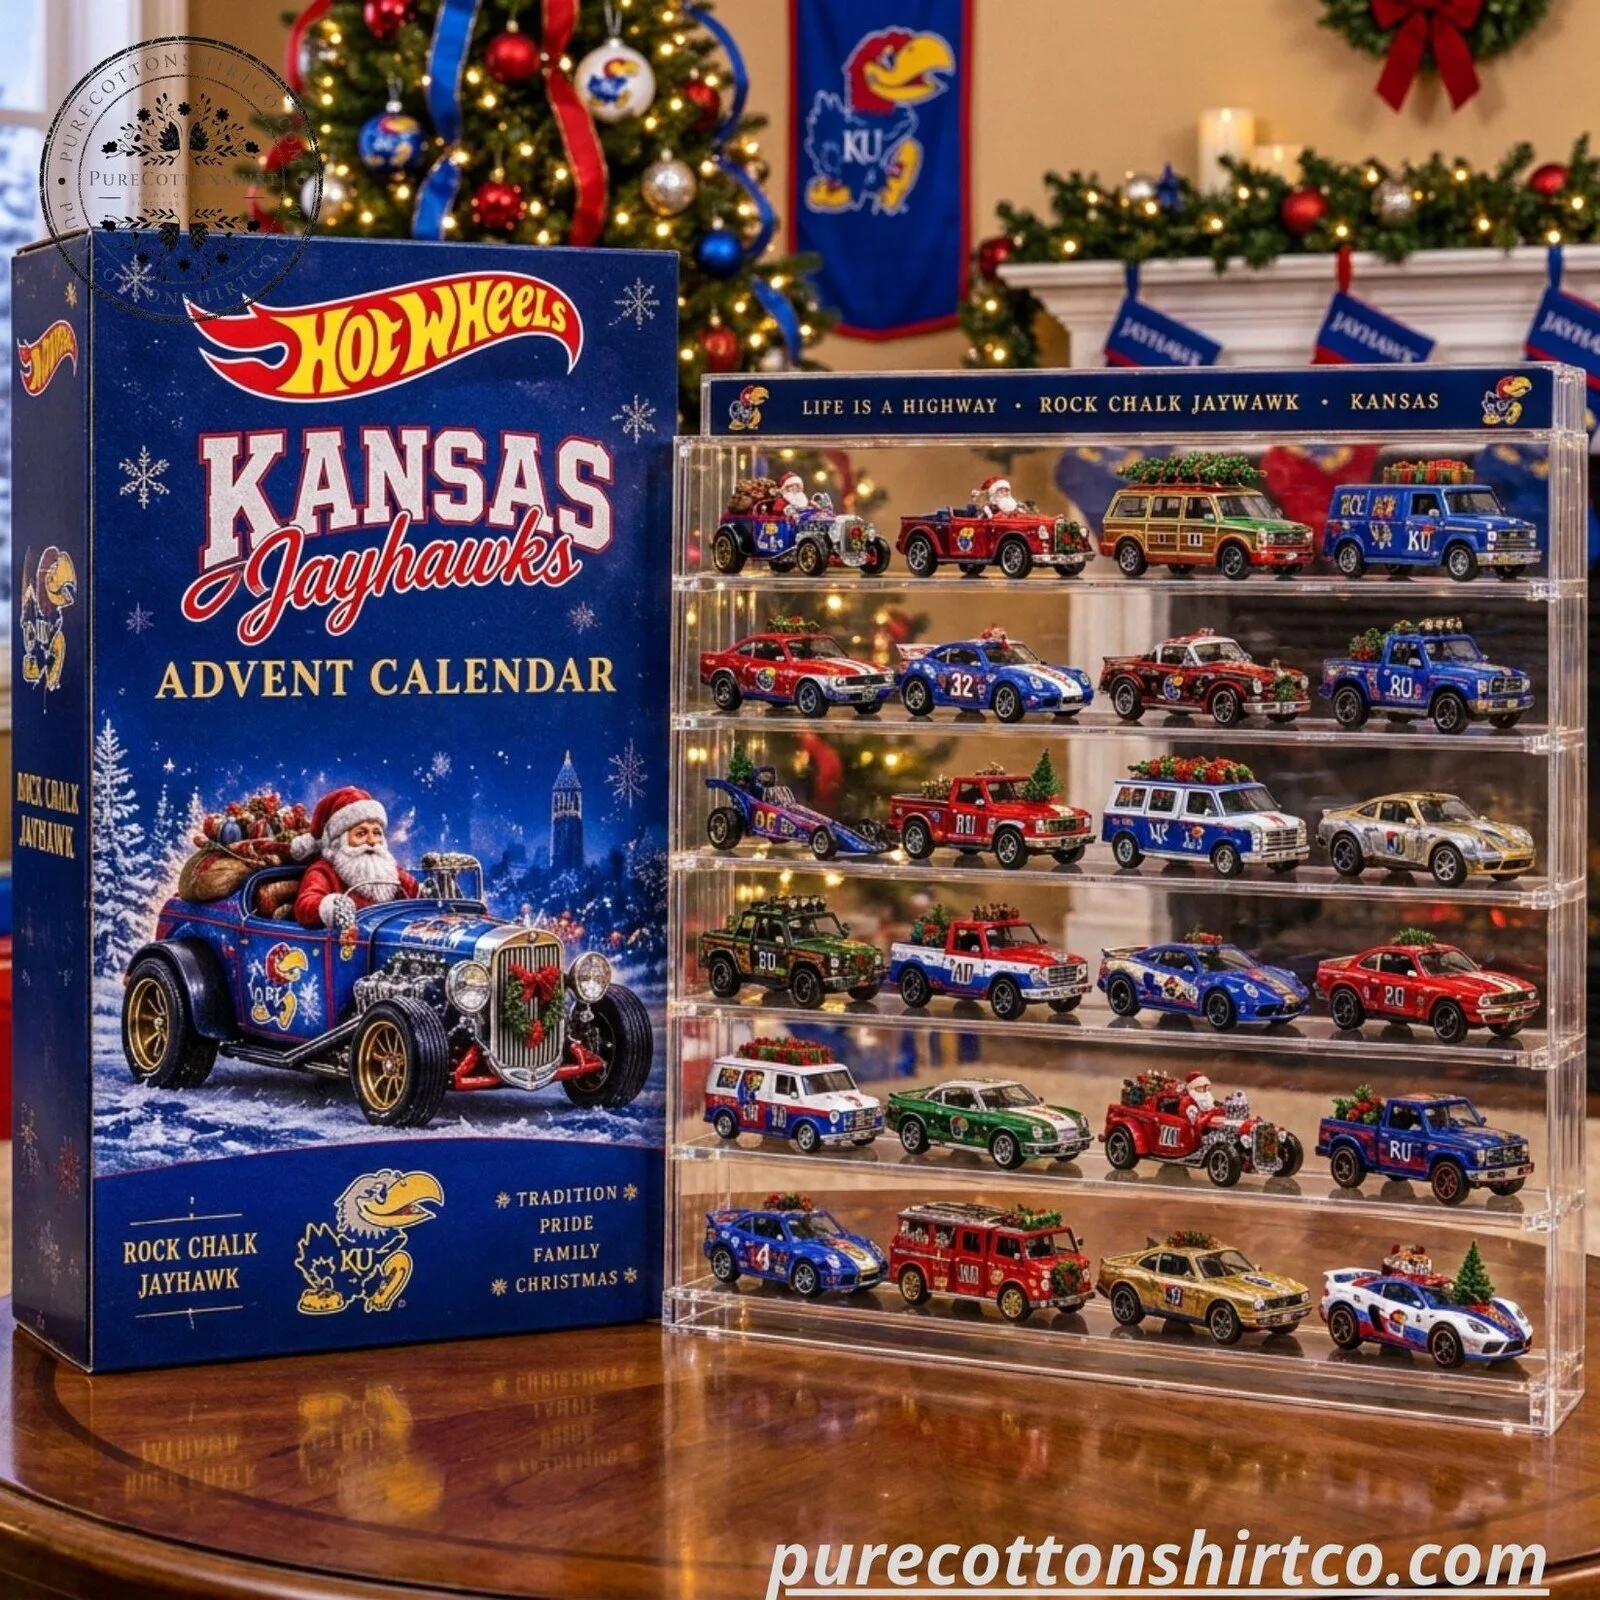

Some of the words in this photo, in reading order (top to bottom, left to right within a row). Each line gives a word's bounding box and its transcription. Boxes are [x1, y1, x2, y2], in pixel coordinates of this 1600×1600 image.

[844, 128, 883, 165] KU
[270, 305, 404, 394] HOT
[389, 279, 567, 376] WHEELS
[803, 399, 844, 415] LIFE
[854, 399, 872, 415] IS
[881, 399, 893, 414] A
[903, 397, 998, 414] HIGHWAY
[1040, 396, 1098, 413] ROCK
[1108, 395, 1182, 413] CHALK
[1191, 393, 1300, 415] JAYWAWK
[1350, 392, 1440, 410] KANSAS
[200, 427, 613, 570] KANSAS
[1407, 529, 1431, 552] KU
[182, 506, 583, 645] Jayhawks
[154, 660, 354, 699] ADVENT
[370, 656, 617, 696] CALENDAR
[950, 672, 973, 698] 32
[1390, 1140, 1412, 1162] RU
[517, 1185, 619, 1208] TRADITION
[539, 1216, 594, 1235] PRIDE
[123, 1238, 179, 1265] ROCK
[188, 1233, 258, 1260] CHALK
[341, 1247, 374, 1276] KU
[533, 1243, 601, 1264] FAMILY
[137, 1267, 240, 1299] JAYHAWK
[515, 1270, 619, 1294] CHRISTMAS
